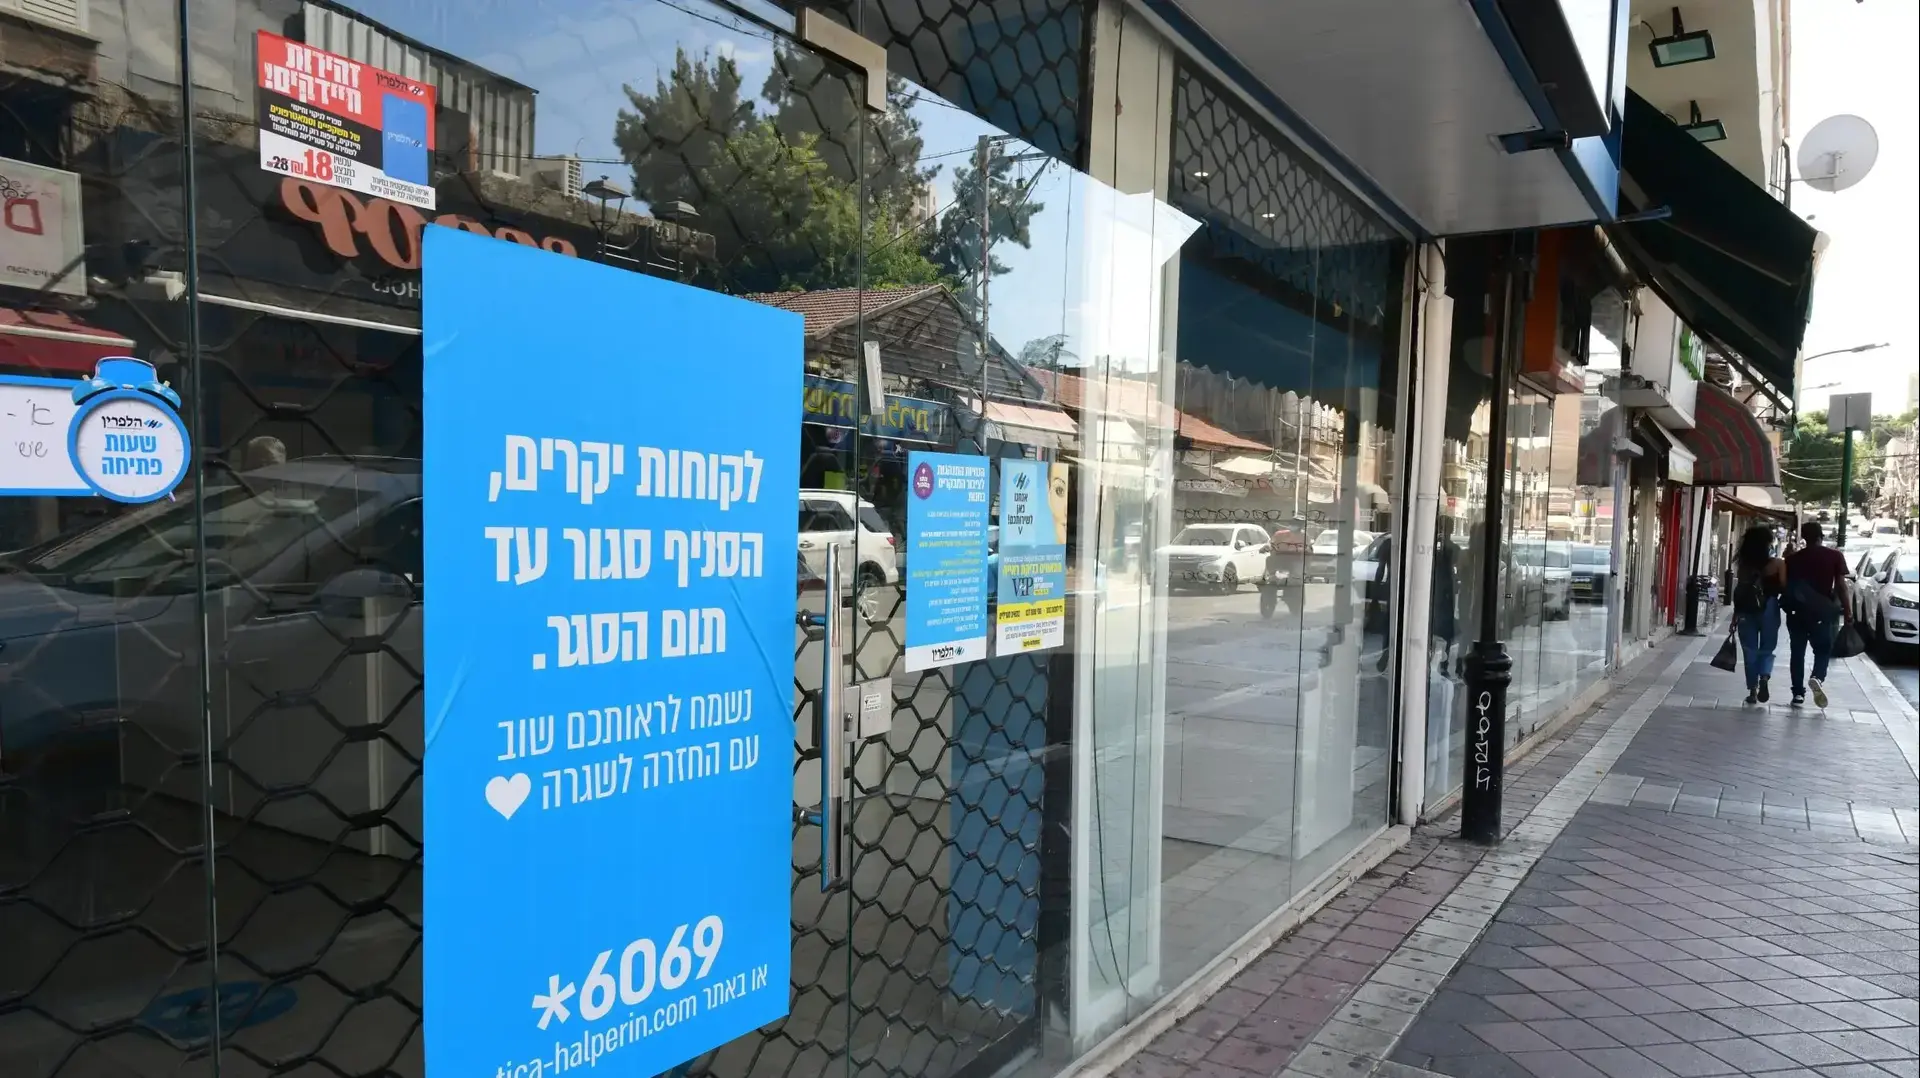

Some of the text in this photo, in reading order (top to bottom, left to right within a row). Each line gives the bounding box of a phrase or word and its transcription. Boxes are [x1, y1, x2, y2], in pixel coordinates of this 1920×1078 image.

[285, 42, 361, 88] זהירות
[264, 63, 362, 115] חיידקים!
[376, 73, 408, 92] הלפרין
[317, 121, 348, 138] משקפיים
[349, 131, 360, 142] של
[326, 140, 334, 149] על
[334, 155, 352, 166] עכשיו
[334, 165, 356, 178] במבצע
[334, 175, 352, 187] מיוחד
[101, 416, 142, 429] הלפרין
[104, 433, 157, 453] שעות
[102, 457, 163, 475] פתיחה
[489, 434, 764, 511] לקוחות יקרים,
[484, 526, 763, 587] הסניף סגור עד
[532, 607, 726, 670] תום הסגר.
[931, 645, 954, 662] הלפרין
[498, 689, 752, 761] נשמח לראותכם שוב
[542, 735, 759, 810] עם החזרה לשגרה
[751, 964, 768, 990] או
[703, 973, 747, 1011] באתר
